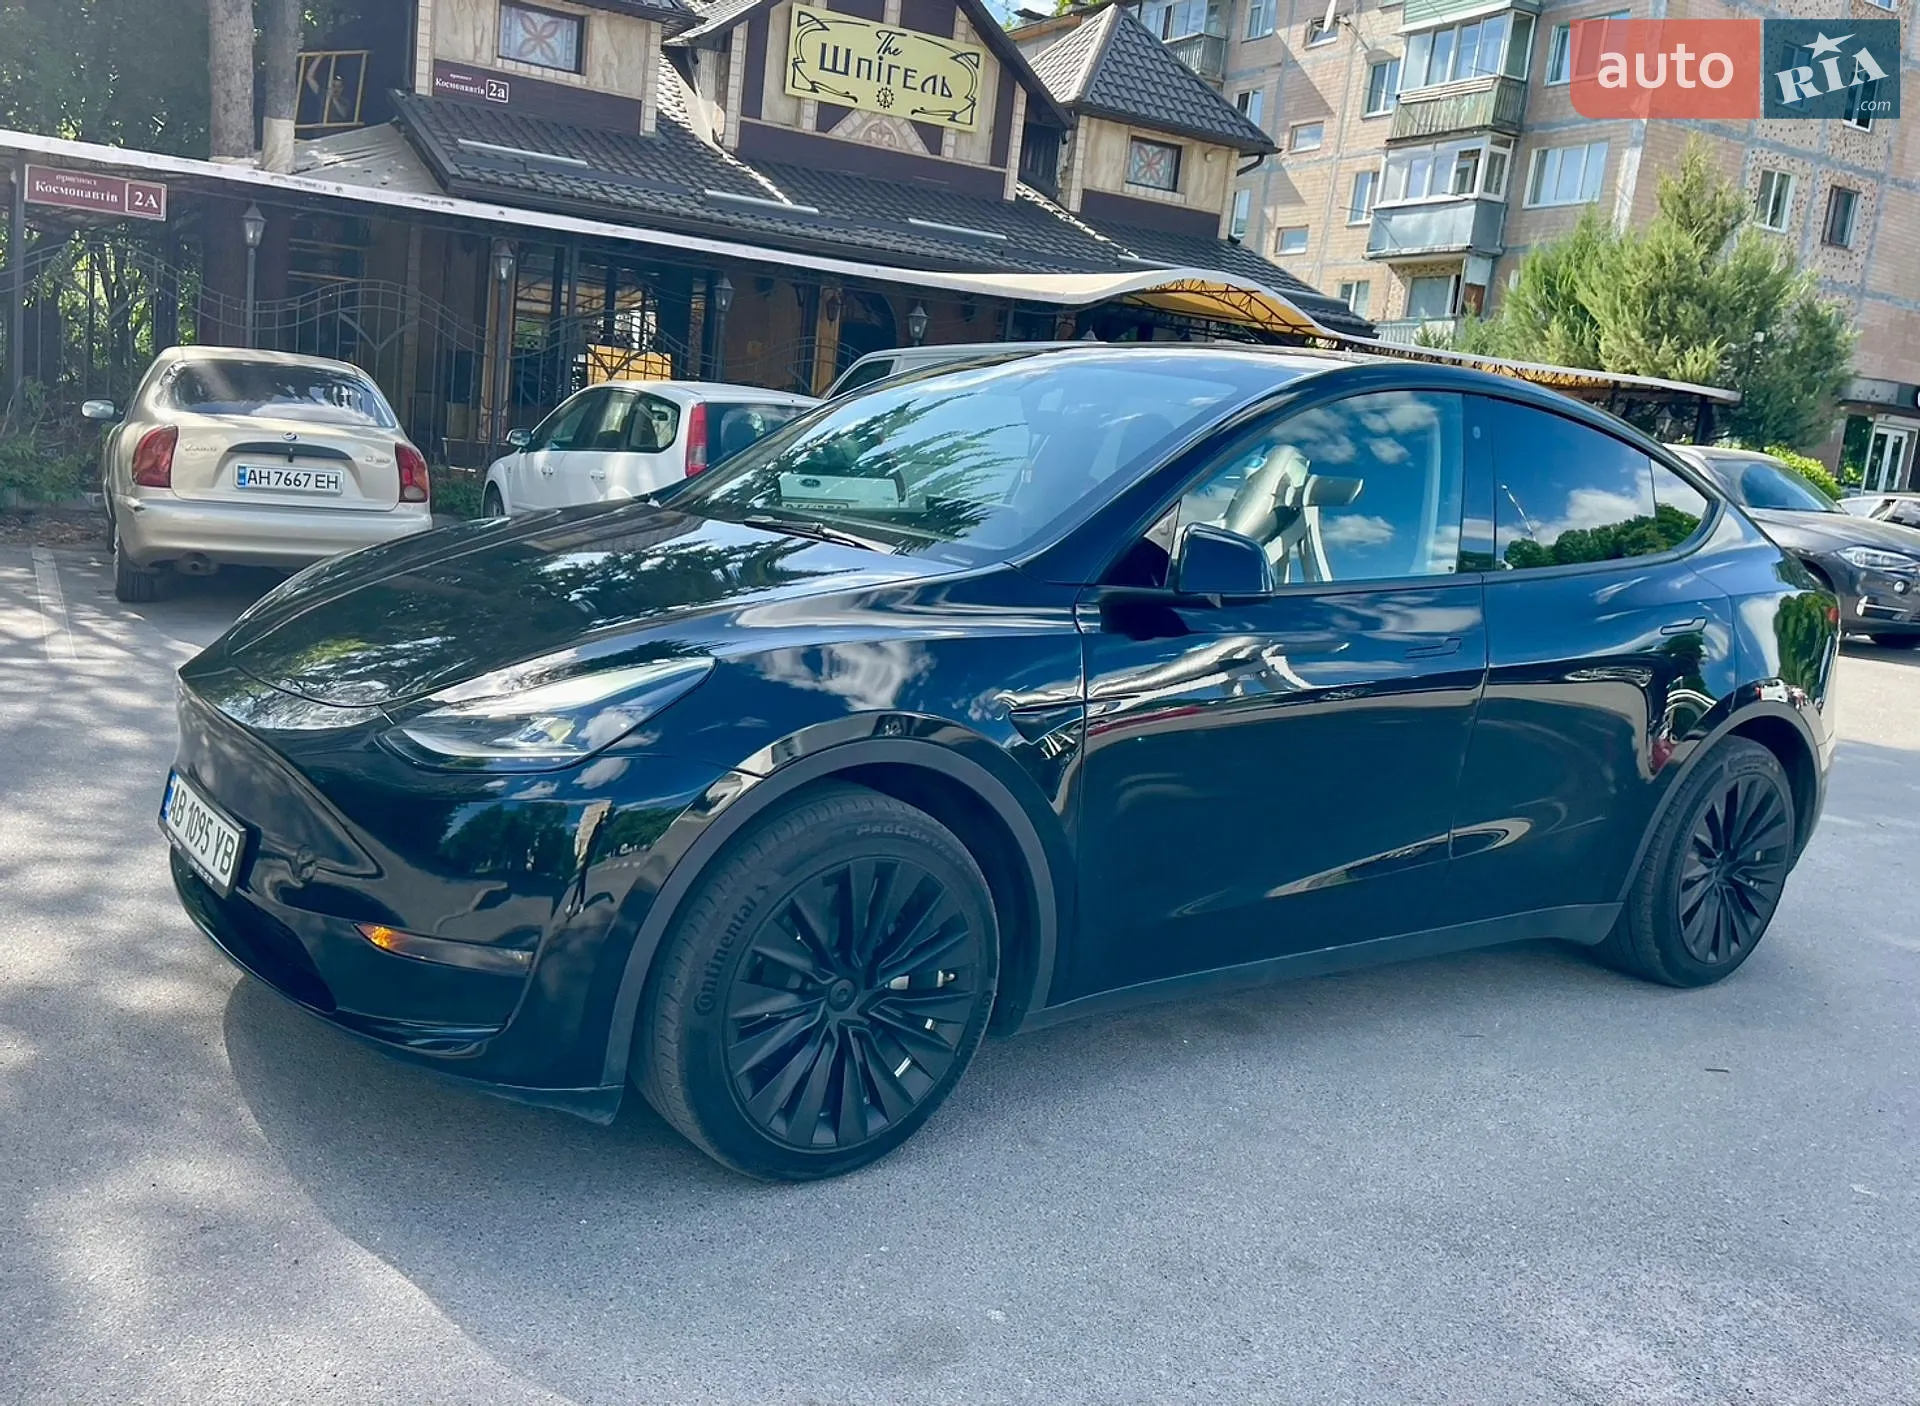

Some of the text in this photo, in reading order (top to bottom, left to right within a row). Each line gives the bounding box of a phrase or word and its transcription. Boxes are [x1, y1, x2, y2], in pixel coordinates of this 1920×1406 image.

[875, 30, 907, 56] The
[134, 191, 159, 208] 2А
[247, 469, 338, 489] AH 7667 EH
[170, 783, 188, 828] AB
[185, 801, 214, 856] 1095
[212, 826, 236, 876] YB
